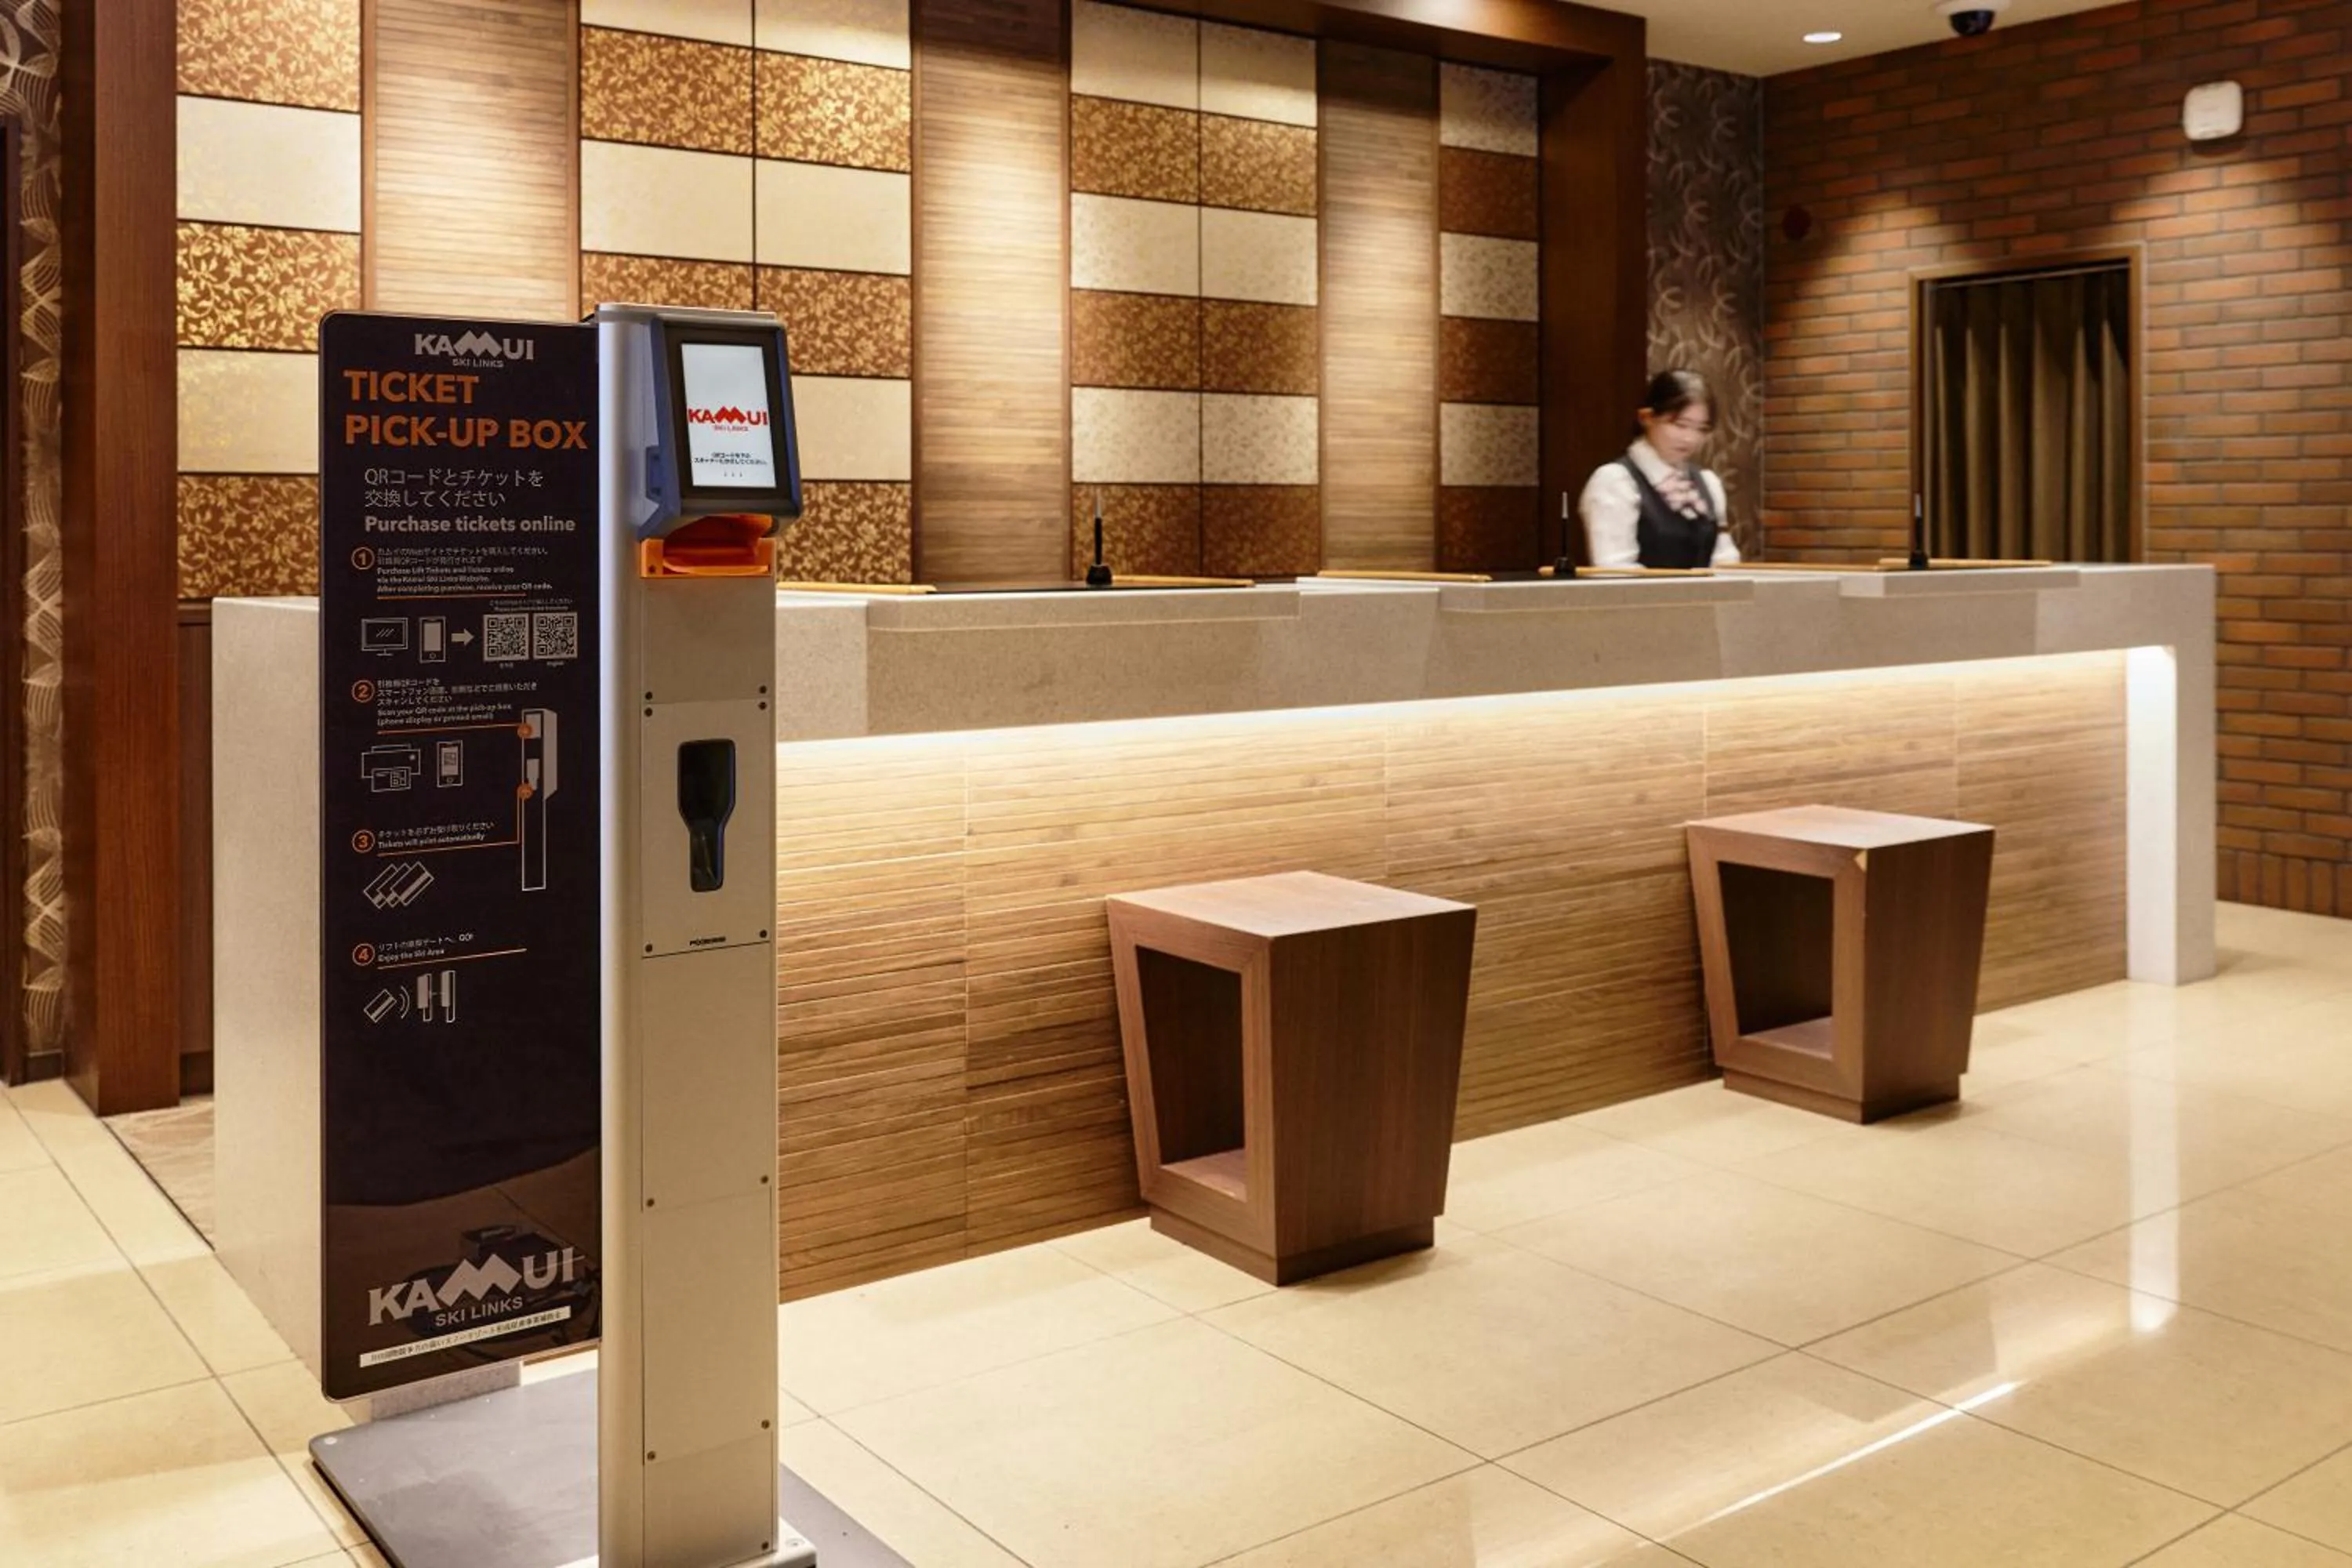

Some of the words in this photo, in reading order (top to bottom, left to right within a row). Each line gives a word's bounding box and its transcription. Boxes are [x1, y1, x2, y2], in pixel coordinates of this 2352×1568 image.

[414, 329, 534, 360] KAMUI
[452, 358, 470, 367] SKI
[473, 358, 504, 368] LINKS
[343, 369, 479, 404] TICKET
[345, 414, 499, 448] PICK-UP
[510, 419, 587, 449] BOX
[365, 468, 544, 486] QRコードとチケットを
[365, 489, 506, 507] 交換してください
[365, 515, 451, 532] Purchase
[456, 515, 516, 532] tickets
[520, 515, 576, 532] online
[368, 1247, 575, 1326] KAMUI
[434, 1307, 465, 1327] SKI
[471, 1296, 523, 1319] LINKS
